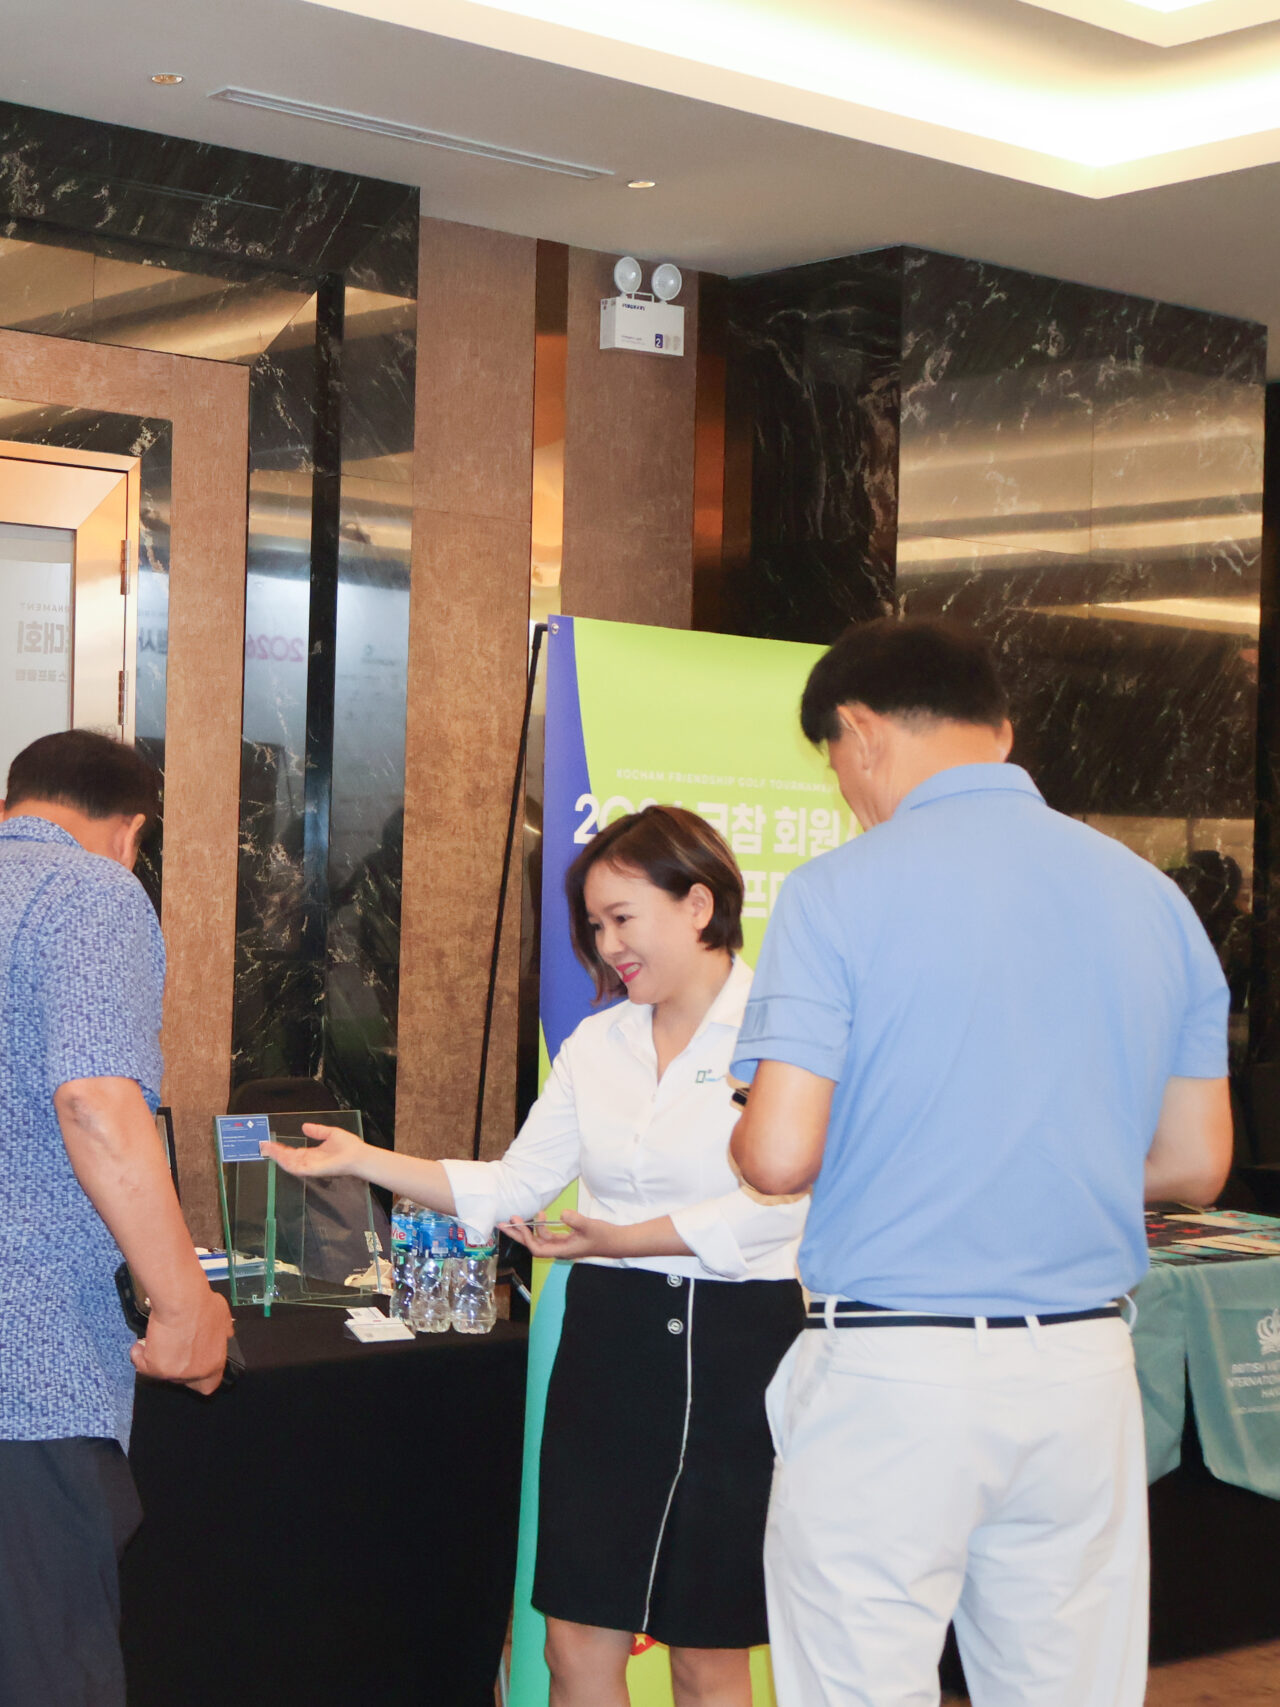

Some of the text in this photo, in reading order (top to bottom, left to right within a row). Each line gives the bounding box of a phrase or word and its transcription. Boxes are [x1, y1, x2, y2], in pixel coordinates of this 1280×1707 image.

[616, 767, 665, 781] KOCHAM
[668, 770, 735, 786] FRIENDSHIP
[737, 776, 766, 789] GOLF
[774, 806, 865, 857] 회원
